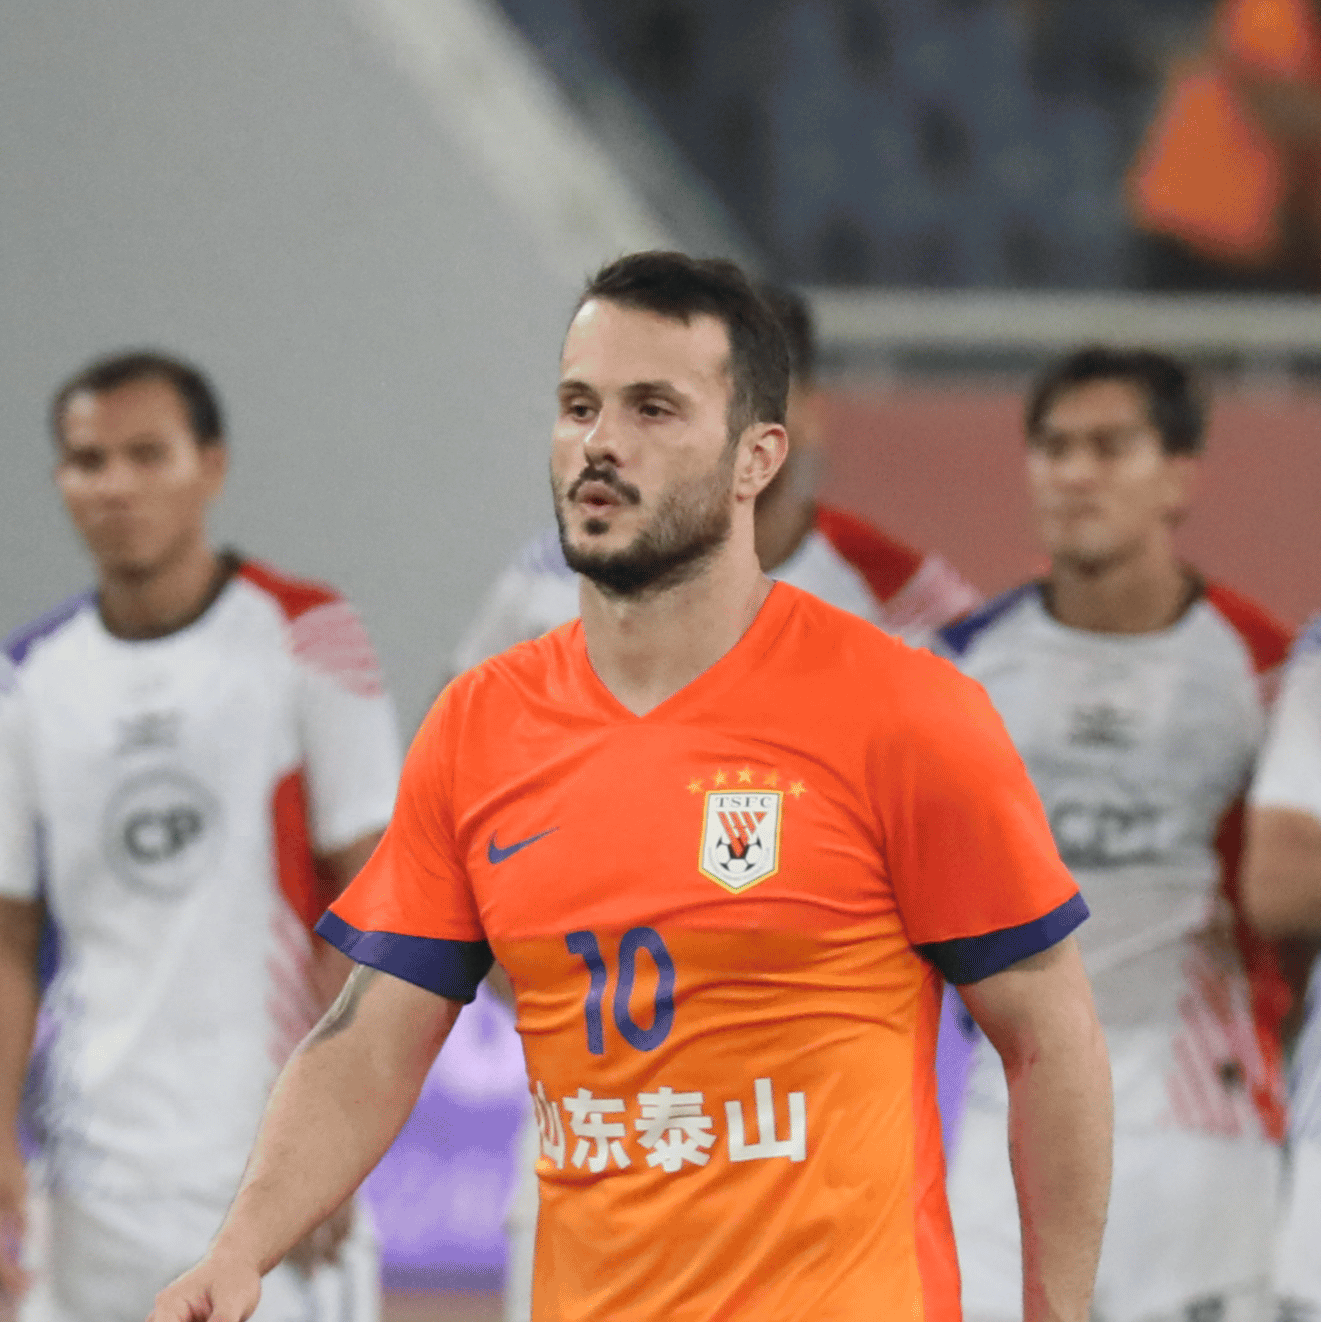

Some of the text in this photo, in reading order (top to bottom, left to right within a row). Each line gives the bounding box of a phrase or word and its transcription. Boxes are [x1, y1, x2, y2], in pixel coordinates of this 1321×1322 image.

[714, 796, 773, 808] TSFC
[123, 806, 203, 867] CP
[565, 926, 676, 1055] 10
